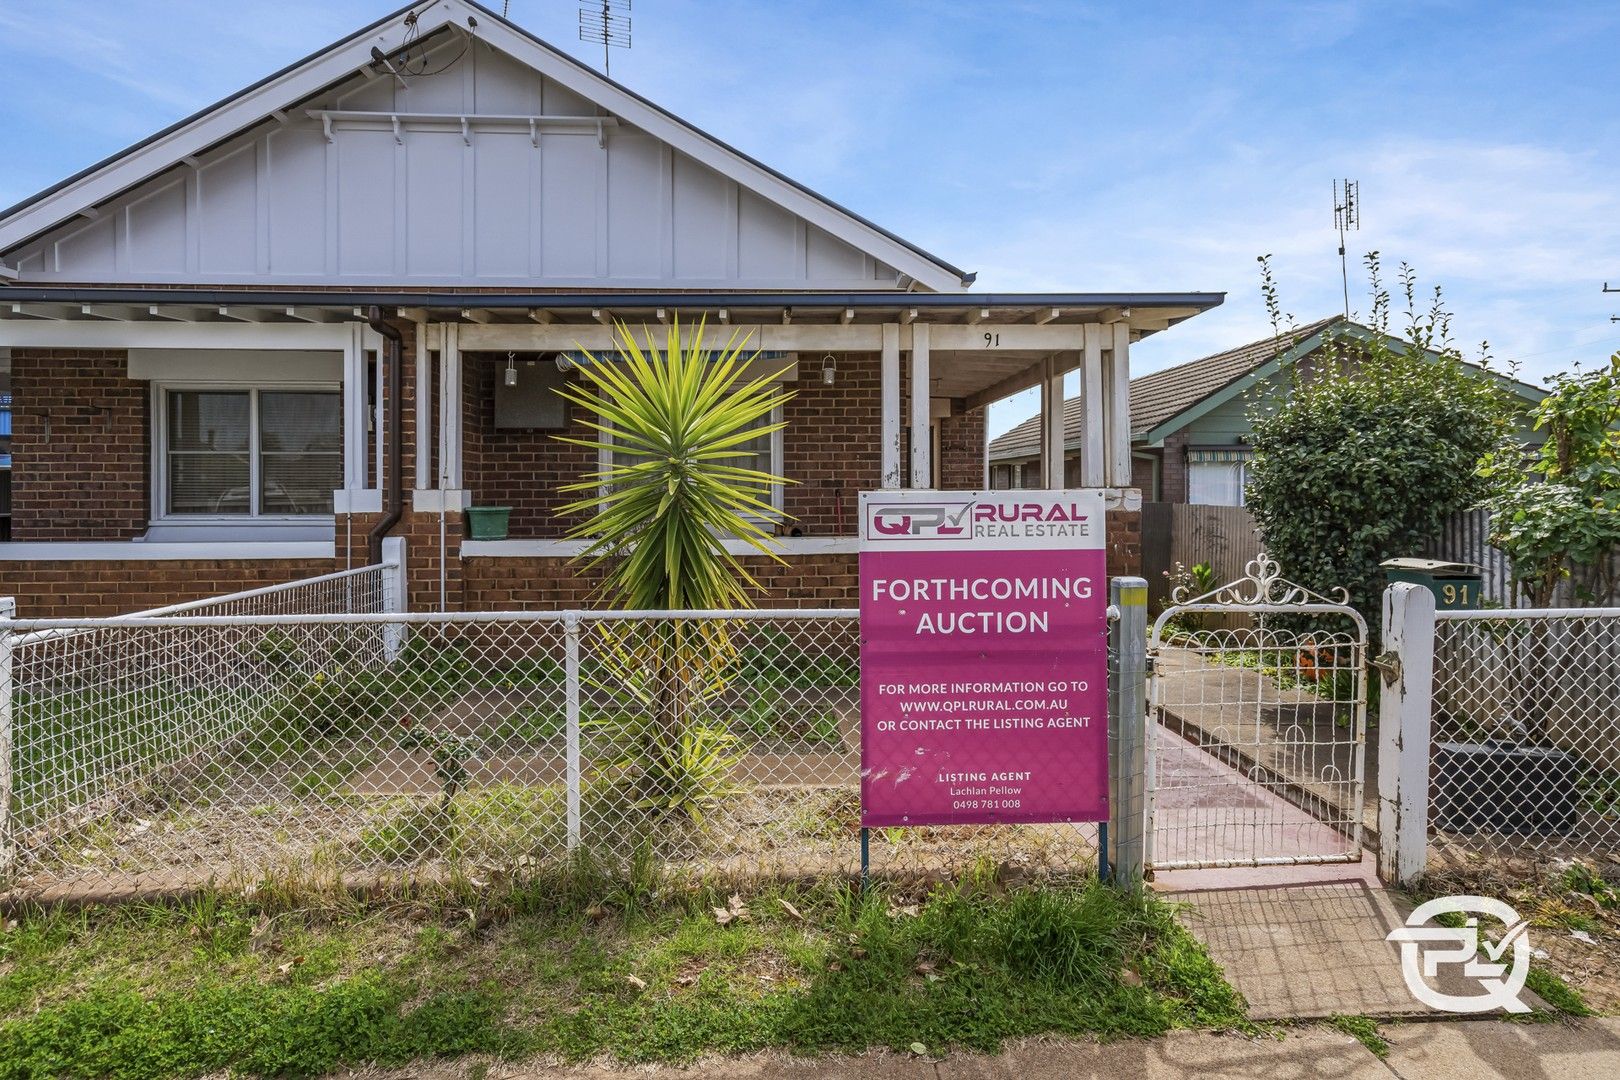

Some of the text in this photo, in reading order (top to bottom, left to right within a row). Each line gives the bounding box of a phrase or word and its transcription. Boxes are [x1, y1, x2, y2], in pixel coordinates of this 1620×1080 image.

[984, 332, 999, 348] 91
[975, 504, 1088, 521] RURAL
[975, 524, 1089, 537] REAL ESTATE
[873, 577, 1092, 601] FORTHCOMING
[1442, 584, 1468, 605] 91
[916, 612, 1048, 634] AUCTION
[879, 682, 1088, 694] FOR MORE INFORMATION GO TO
[900, 700, 1067, 712] WWW.QPLRURAL.COM.AU
[877, 717, 1090, 731] OR CONTACT THE LISTING AGENT
[939, 772, 1031, 782] LISTING AGENT
[950, 786, 1021, 795] Lachlan Pellow
[953, 800, 1020, 809] 0498 781 008
